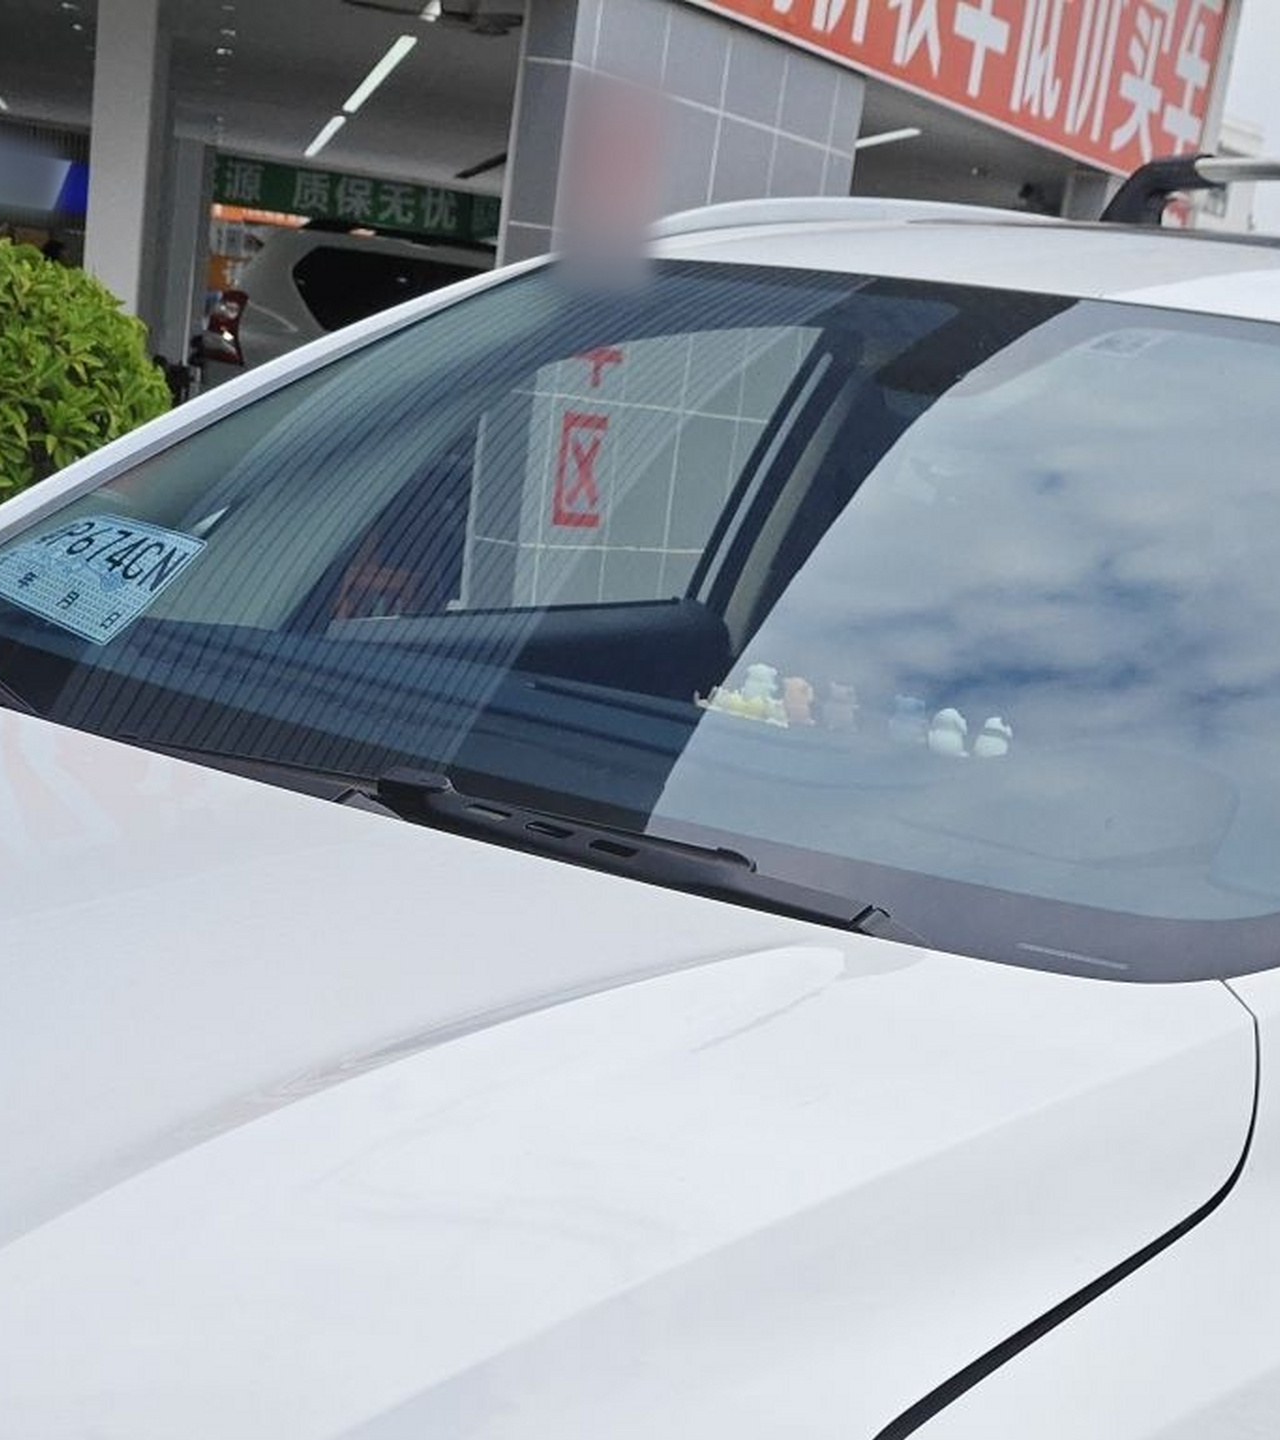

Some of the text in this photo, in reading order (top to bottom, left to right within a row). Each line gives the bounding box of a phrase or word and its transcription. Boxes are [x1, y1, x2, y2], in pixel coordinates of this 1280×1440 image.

[291, 169, 458, 230] 质保无忧
[54, 590, 80, 610] 月
[100, 612, 121, 630] 日
